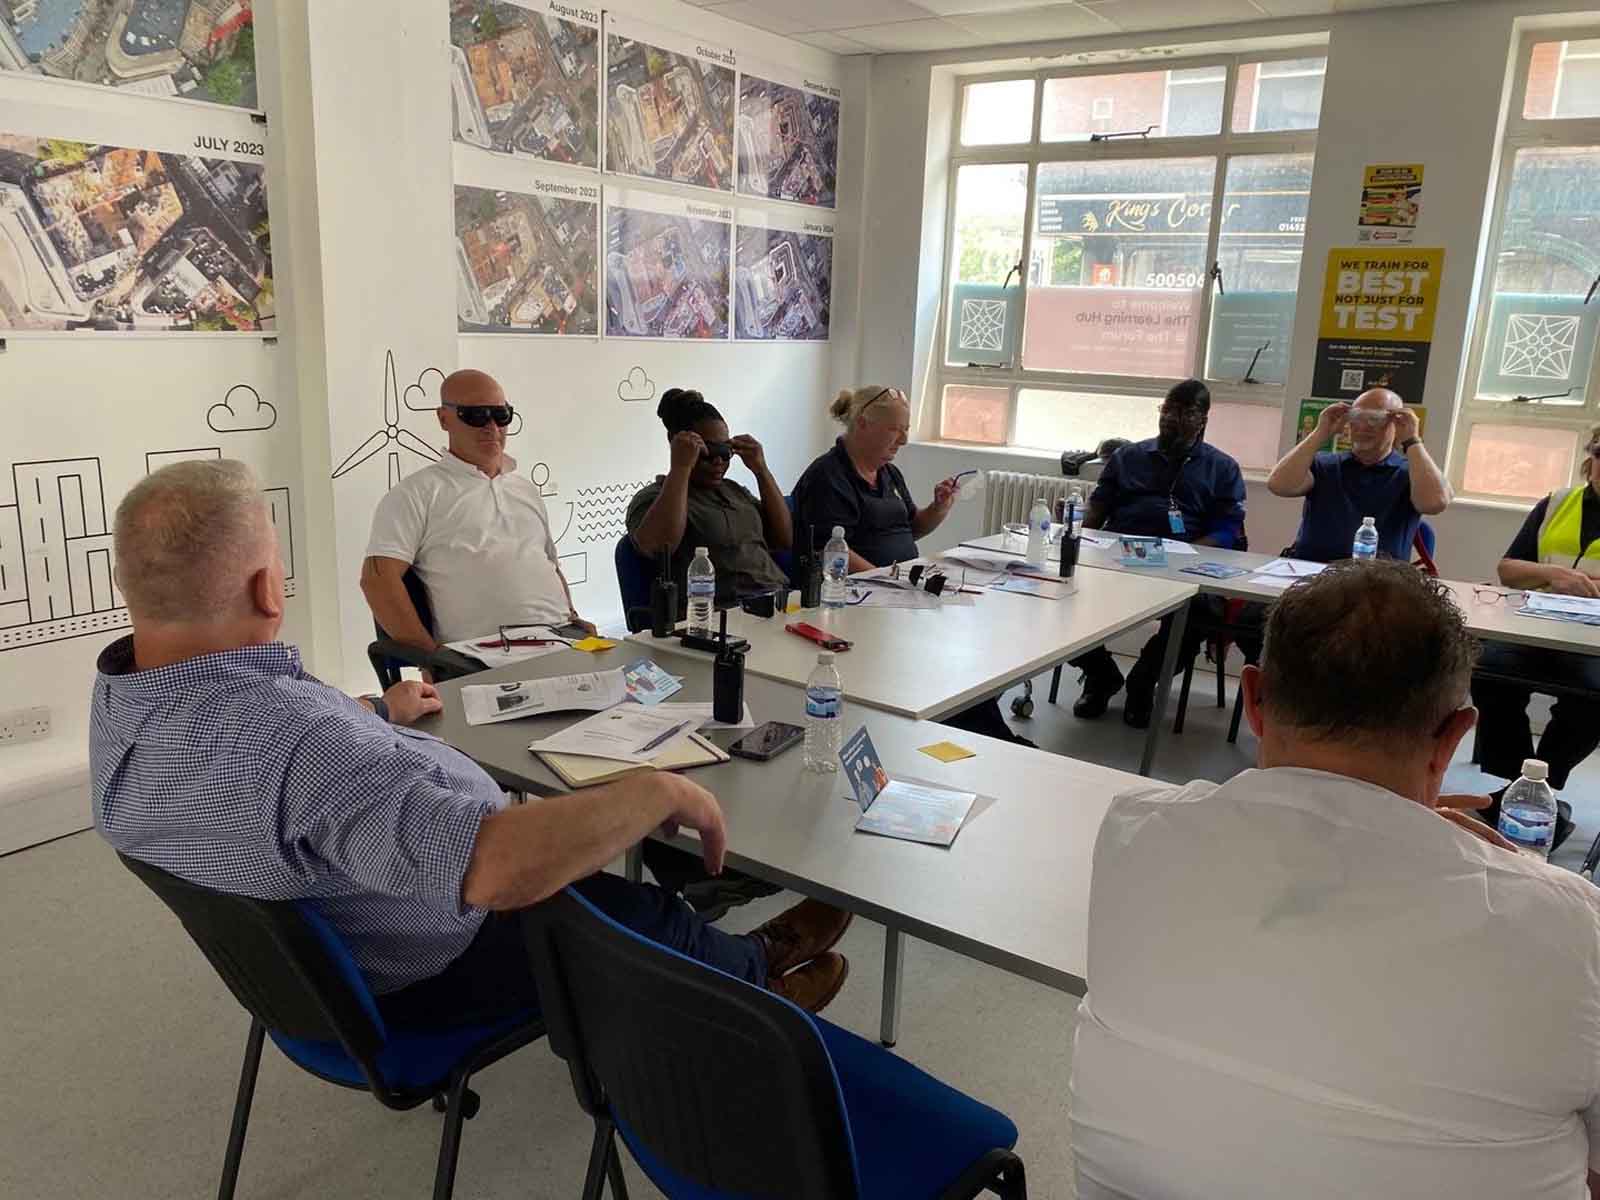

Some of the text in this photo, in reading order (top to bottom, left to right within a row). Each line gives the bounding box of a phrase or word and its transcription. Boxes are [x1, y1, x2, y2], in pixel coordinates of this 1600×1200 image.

[549, 1, 599, 24] August 2023
[696, 46, 737, 65] October 2023
[193, 135, 265, 156] JULY 2023
[534, 179, 597, 198] September 2023
[1167, 198, 1240, 228] Corr
[1340, 260, 1430, 270] WE TRAIN FOR
[1336, 271, 1431, 296] BEST
[1334, 295, 1425, 305] NOT JUST FOR
[1333, 305, 1425, 331] TEST
